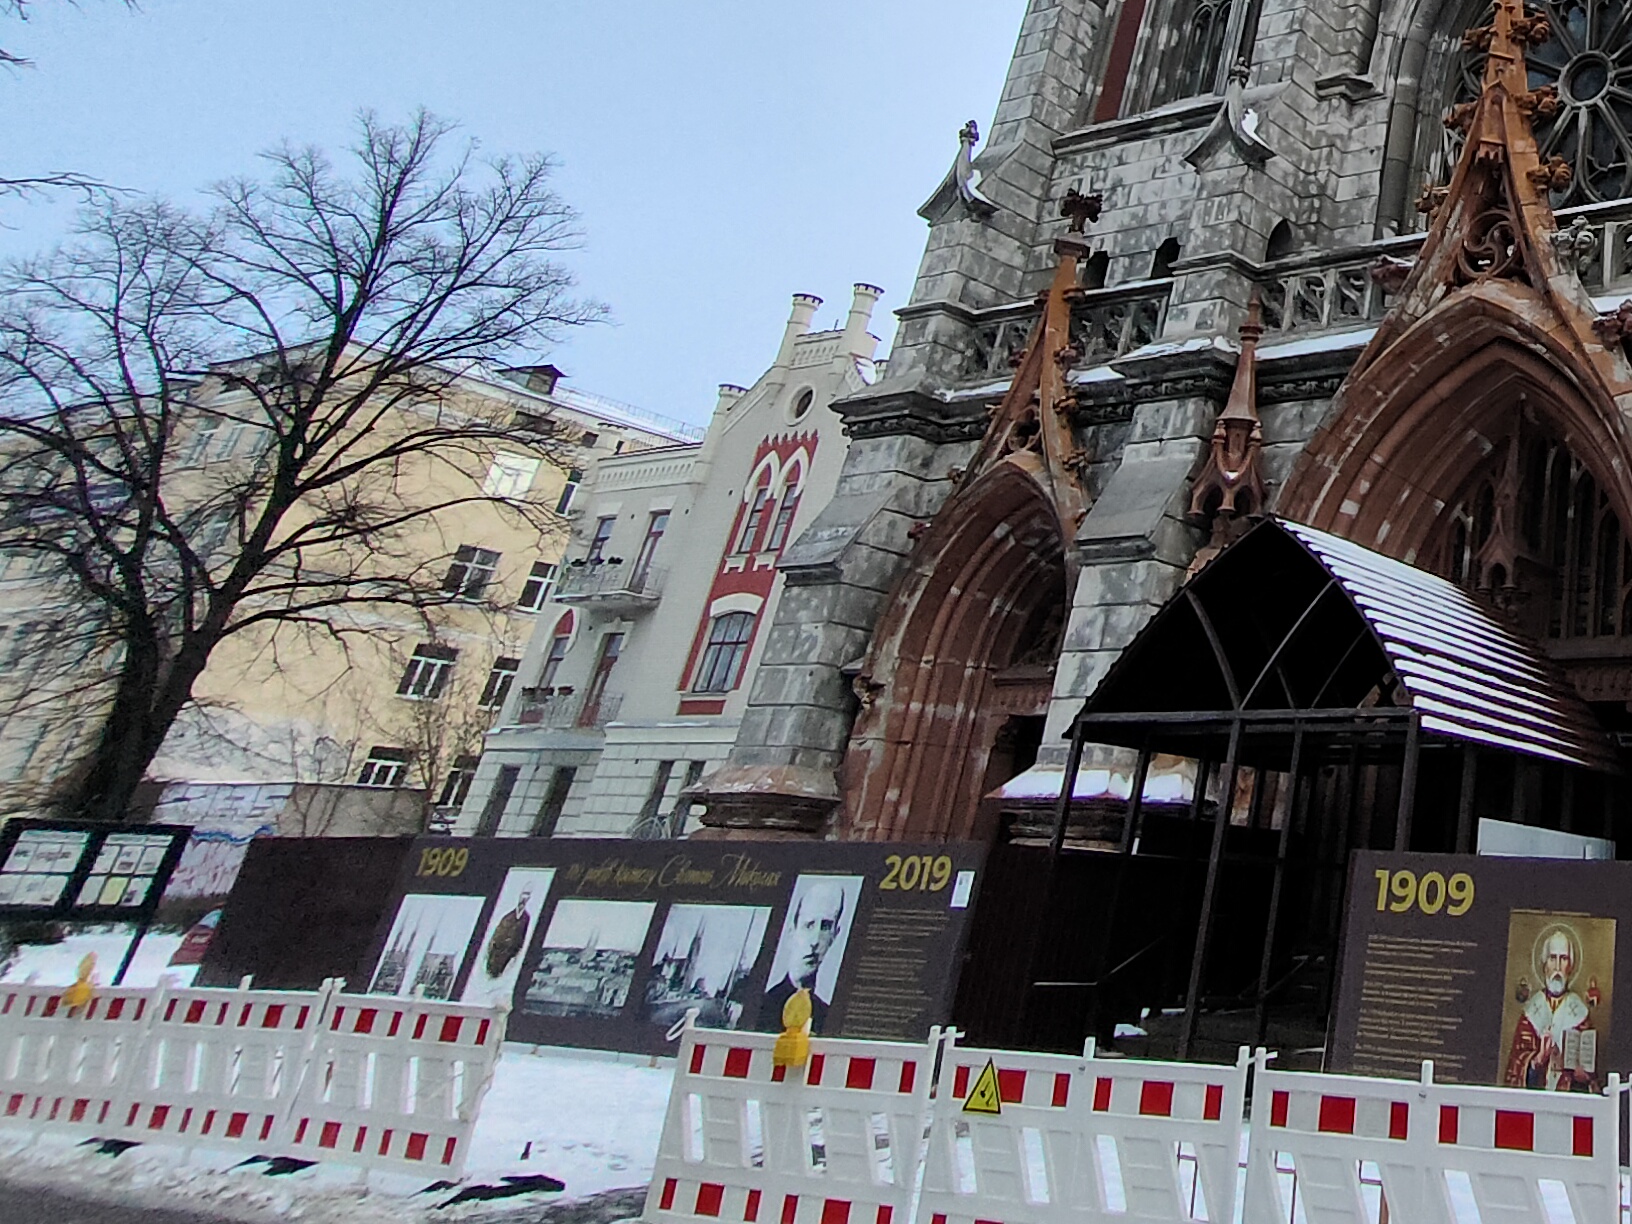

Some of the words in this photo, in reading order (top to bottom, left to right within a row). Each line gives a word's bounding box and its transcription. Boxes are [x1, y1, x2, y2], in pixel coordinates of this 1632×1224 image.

[415, 846, 469, 877] 1909
[879, 855, 952, 891] 2019
[1375, 869, 1475, 916] 1909
